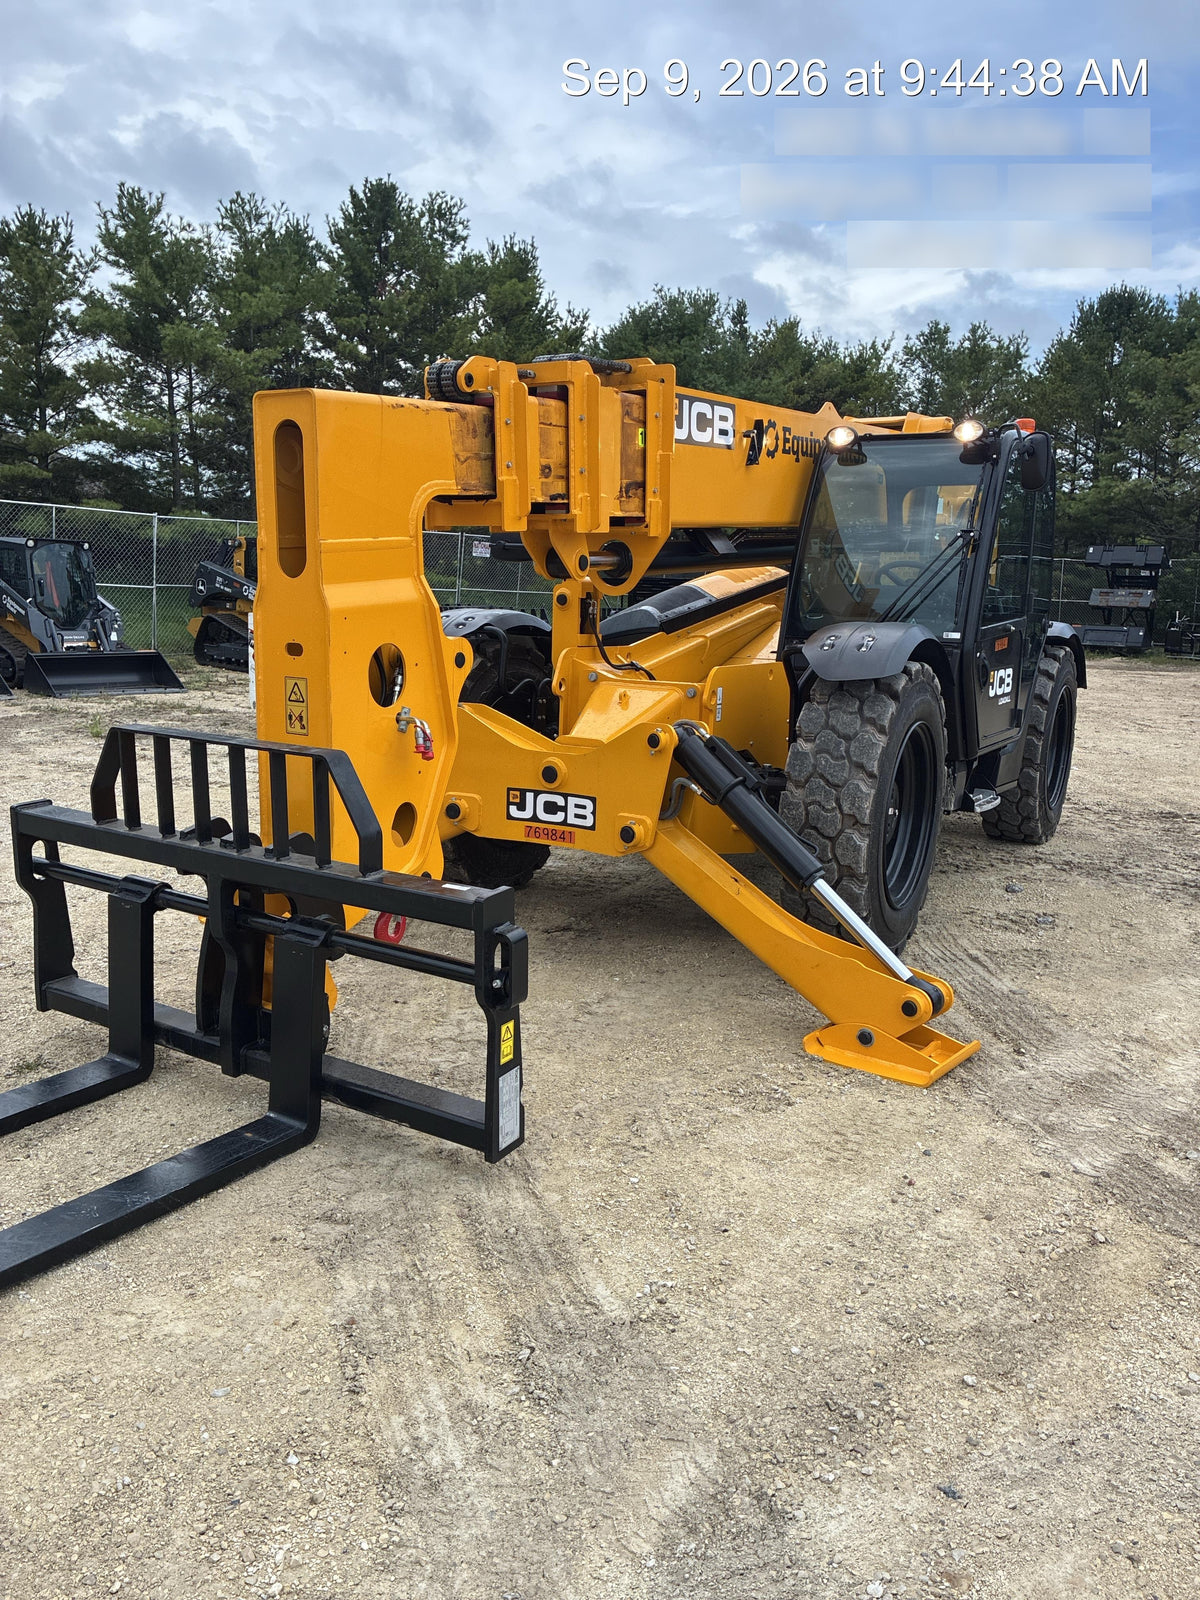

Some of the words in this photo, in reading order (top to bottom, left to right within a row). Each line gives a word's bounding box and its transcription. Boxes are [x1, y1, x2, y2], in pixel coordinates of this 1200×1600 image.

[675, 400, 734, 445] JCB
[782, 426, 826, 464] Equip
[989, 668, 1013, 697] JCB
[509, 792, 594, 827] JCB
[525, 826, 573, 843] 769841
